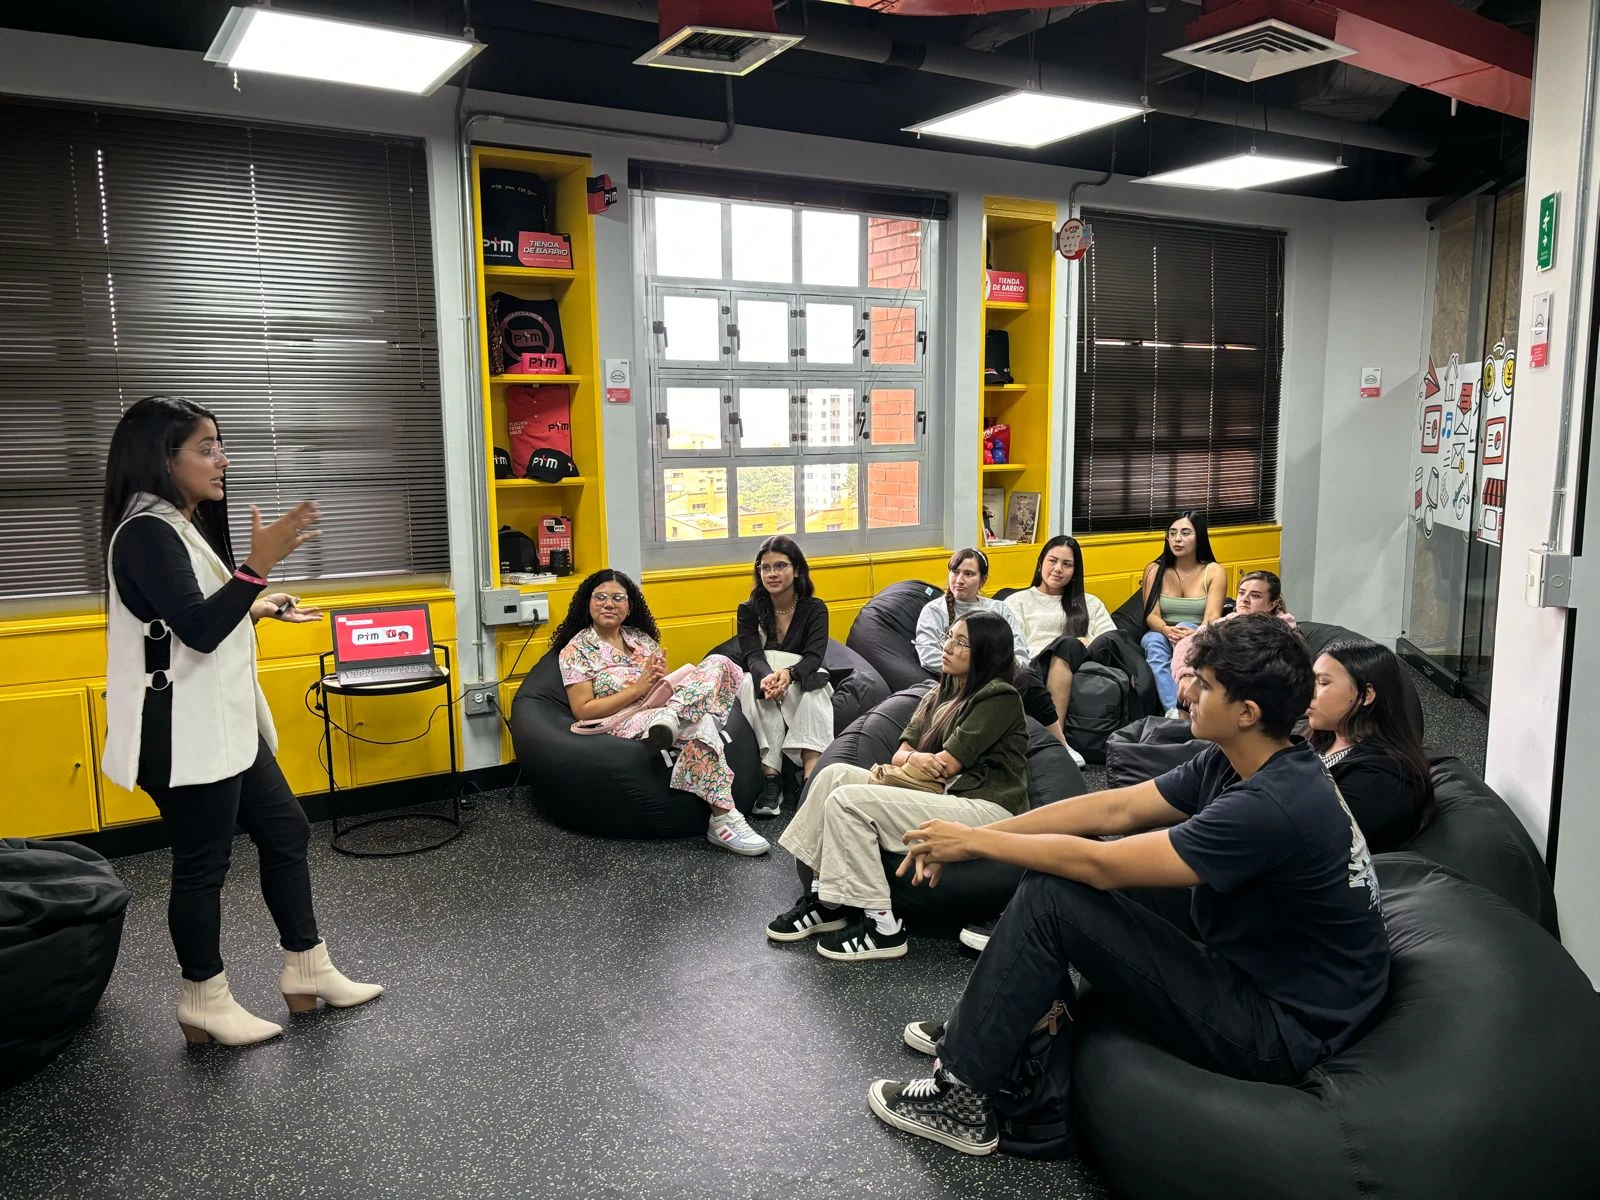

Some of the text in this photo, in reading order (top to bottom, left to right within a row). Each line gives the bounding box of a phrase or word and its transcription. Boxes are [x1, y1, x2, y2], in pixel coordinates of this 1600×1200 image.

[529, 240, 560, 248] TIENDA
[523, 246, 568, 256] DE BARRIO
[998, 277, 1020, 285] TIENDA
[1001, 284, 1024, 292] BARRIO
